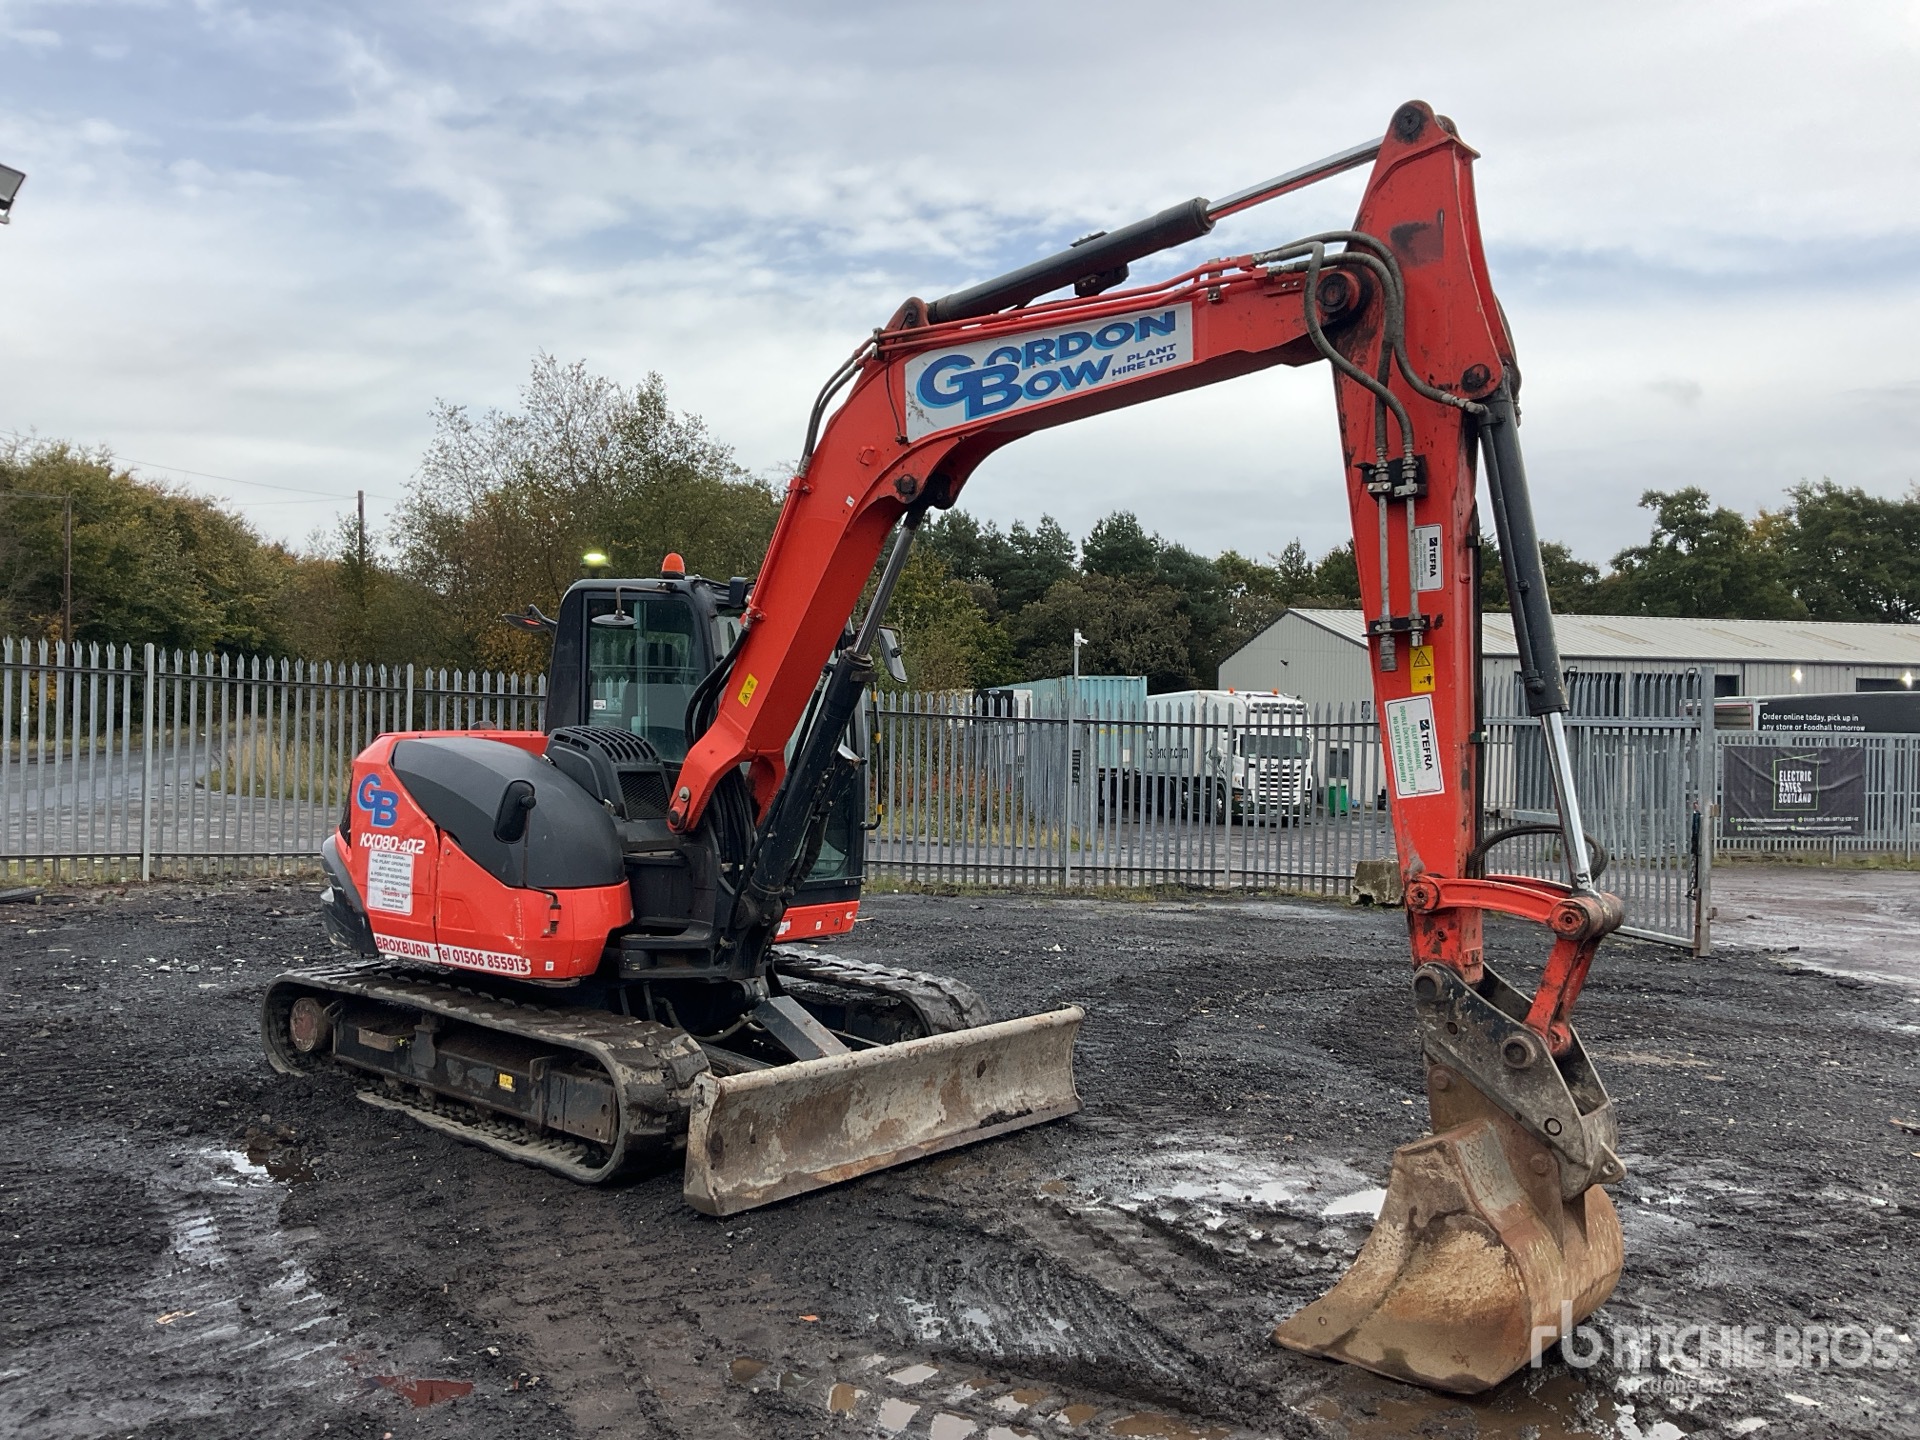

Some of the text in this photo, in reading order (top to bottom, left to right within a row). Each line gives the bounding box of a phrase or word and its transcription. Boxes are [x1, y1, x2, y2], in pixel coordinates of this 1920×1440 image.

[916, 311, 1176, 409] GORDON
[1127, 343, 1176, 363] PLANT
[1111, 352, 1177, 377] HIRE LTD
[1429, 547, 1437, 578] TEFRA
[1399, 706, 1408, 726] DOUBLE
[1783, 713, 1804, 721] online
[1805, 714, 1826, 722] today,
[1827, 714, 1841, 723] pick
[1410, 724, 1418, 739] FULLY
[1803, 723, 1832, 731] Foodhall
[1392, 716, 1399, 725] NO
[1398, 755, 1407, 783] REQUIRED
[1421, 732, 1433, 771] TEFRA
[1779, 770, 1812, 782] ELECTRIC
[1779, 782, 1802, 793] GATES
[357, 773, 399, 828] GB
[1778, 792, 1812, 804] SCOTLAND
[376, 936, 530, 973] BROXBURN Tel 01506 855913
